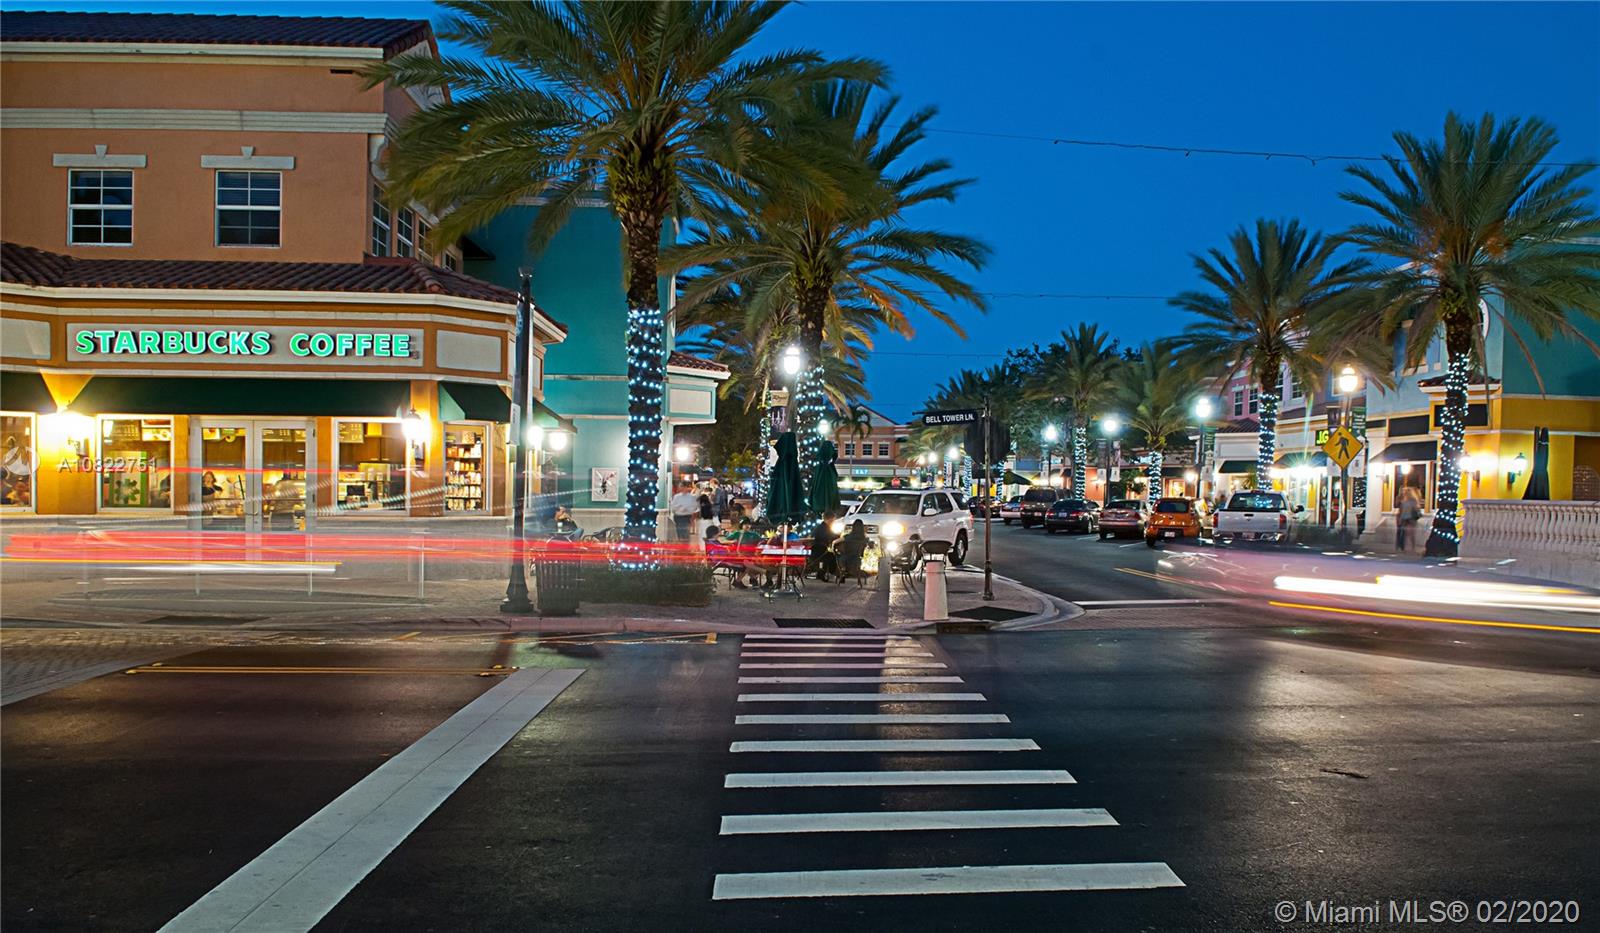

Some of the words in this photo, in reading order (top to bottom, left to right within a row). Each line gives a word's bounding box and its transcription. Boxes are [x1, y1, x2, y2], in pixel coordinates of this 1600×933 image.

[75, 330, 272, 355] STARBUCKS
[289, 332, 411, 357] COFFEE
[925, 415, 941, 424] BELL
[942, 413, 965, 422] TOWER
